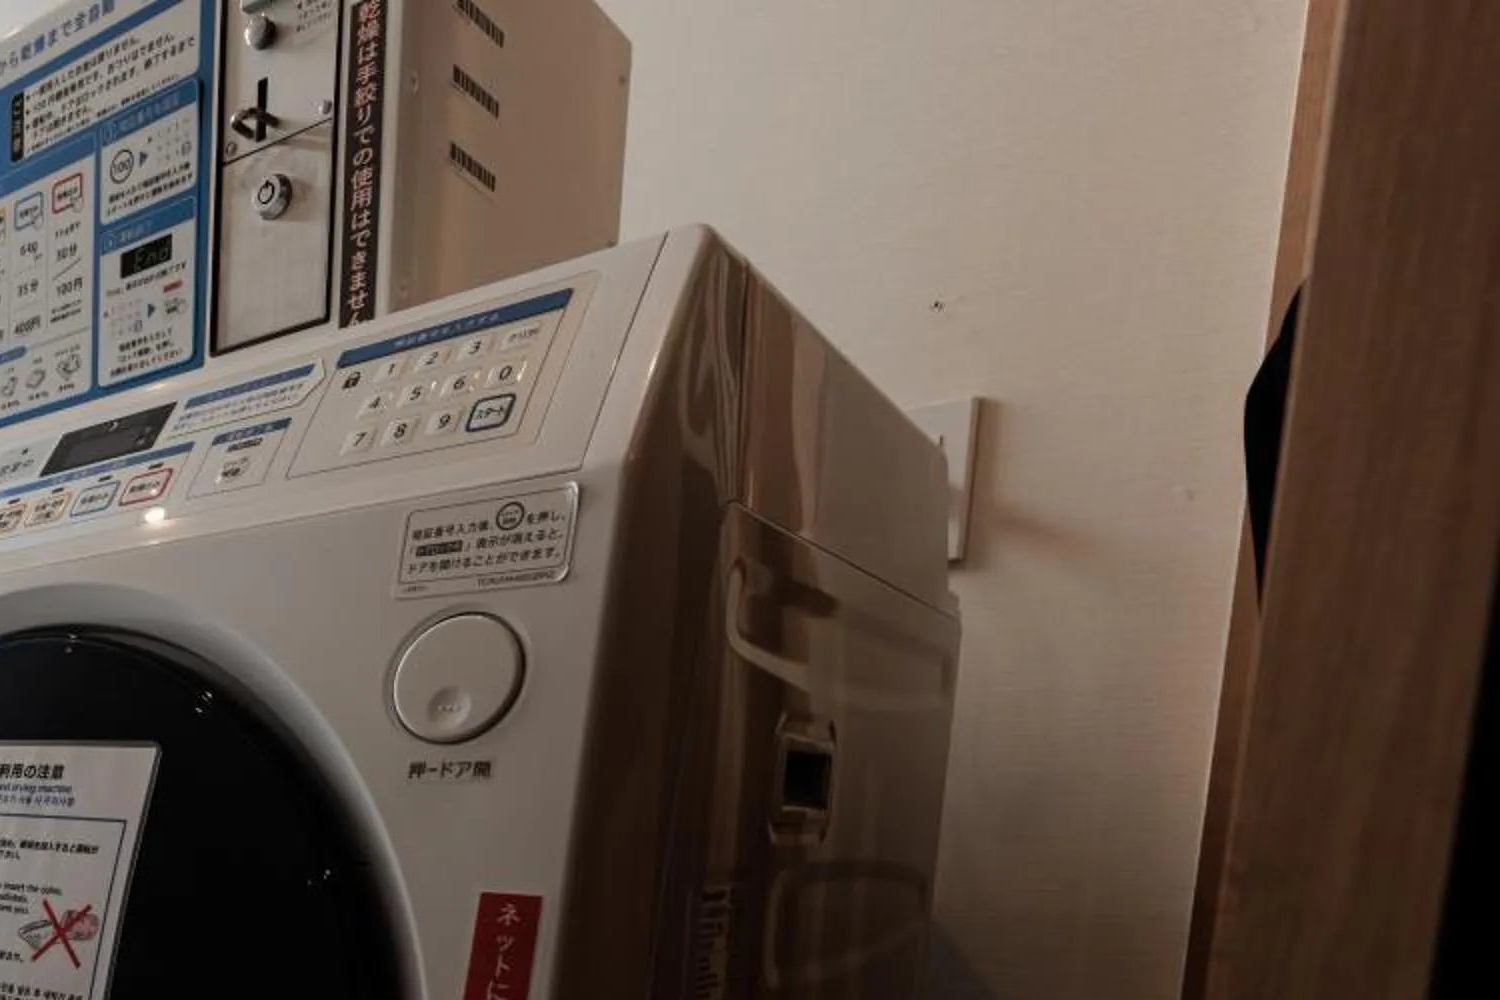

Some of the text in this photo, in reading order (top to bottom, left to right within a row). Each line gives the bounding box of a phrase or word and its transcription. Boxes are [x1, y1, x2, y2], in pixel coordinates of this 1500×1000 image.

[425, 352, 439, 366] 2
[467, 340, 482, 355] 3
[410, 386, 422, 400] 5
[453, 376, 466, 390] 6
[500, 365, 513, 380] 0
[354, 413, 450, 446] 7 8 9
